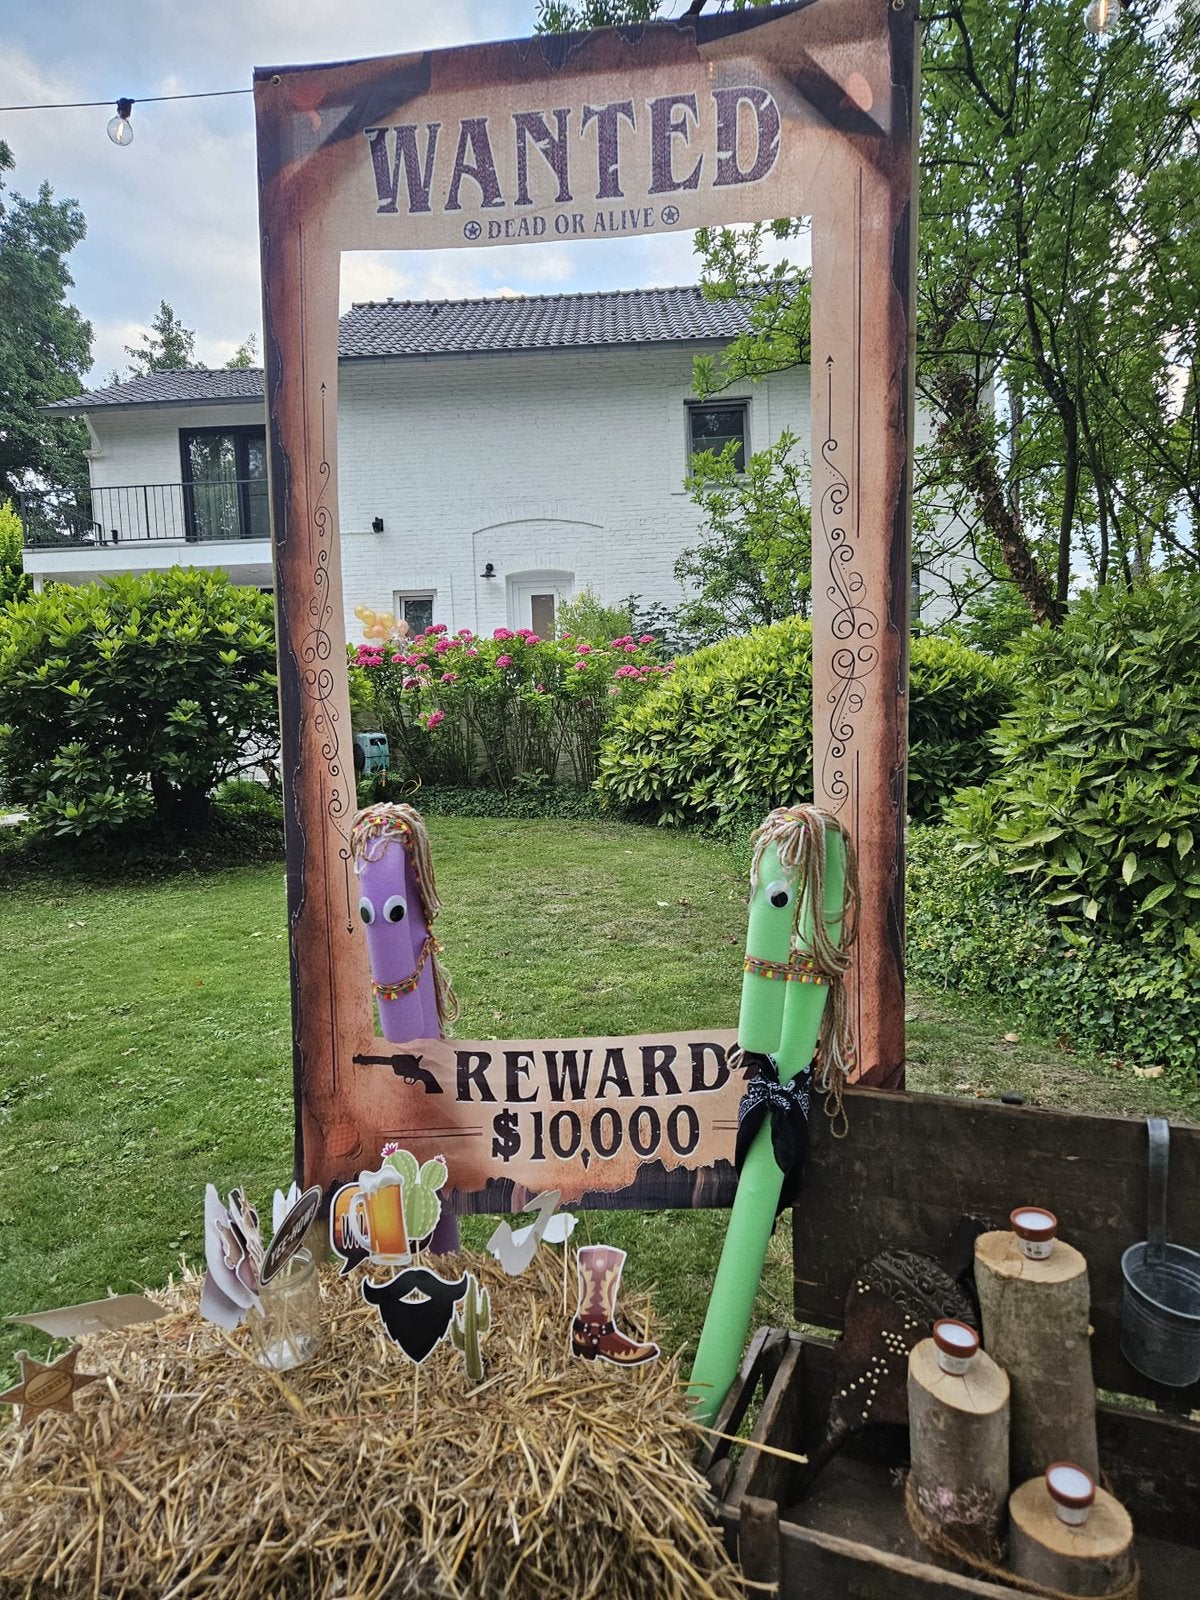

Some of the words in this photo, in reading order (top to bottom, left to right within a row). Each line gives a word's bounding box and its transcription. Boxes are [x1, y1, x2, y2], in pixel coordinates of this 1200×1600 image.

[363, 86, 781, 214] WANTED
[488, 214, 547, 239] DEAD
[554, 213, 585, 234] OR
[594, 207, 655, 231] ALIVE
[454, 1042, 731, 1103] REWARD
[491, 1104, 701, 1169] $10,000
